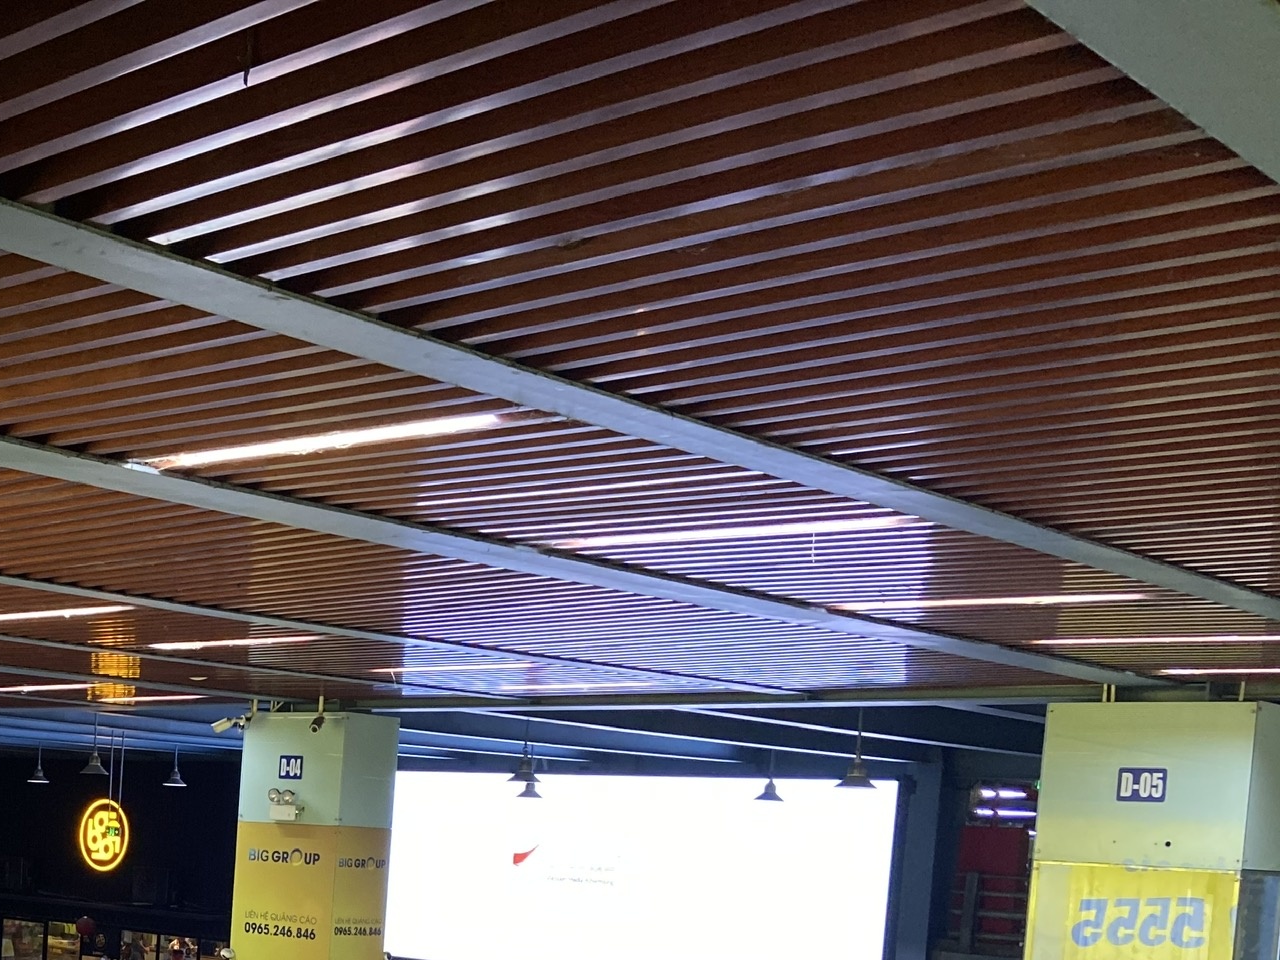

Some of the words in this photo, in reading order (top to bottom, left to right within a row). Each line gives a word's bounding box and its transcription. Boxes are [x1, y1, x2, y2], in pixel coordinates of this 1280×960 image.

[280, 758, 301, 776] D-04
[1120, 773, 1163, 798] D-05
[248, 848, 269, 861] BIG
[271, 848, 320, 866] GROUP
[338, 859, 353, 868] BIG
[354, 857, 386, 869] GROUP
[244, 922, 316, 940] 0965.246.846
[334, 926, 381, 936] 0965.246.846
